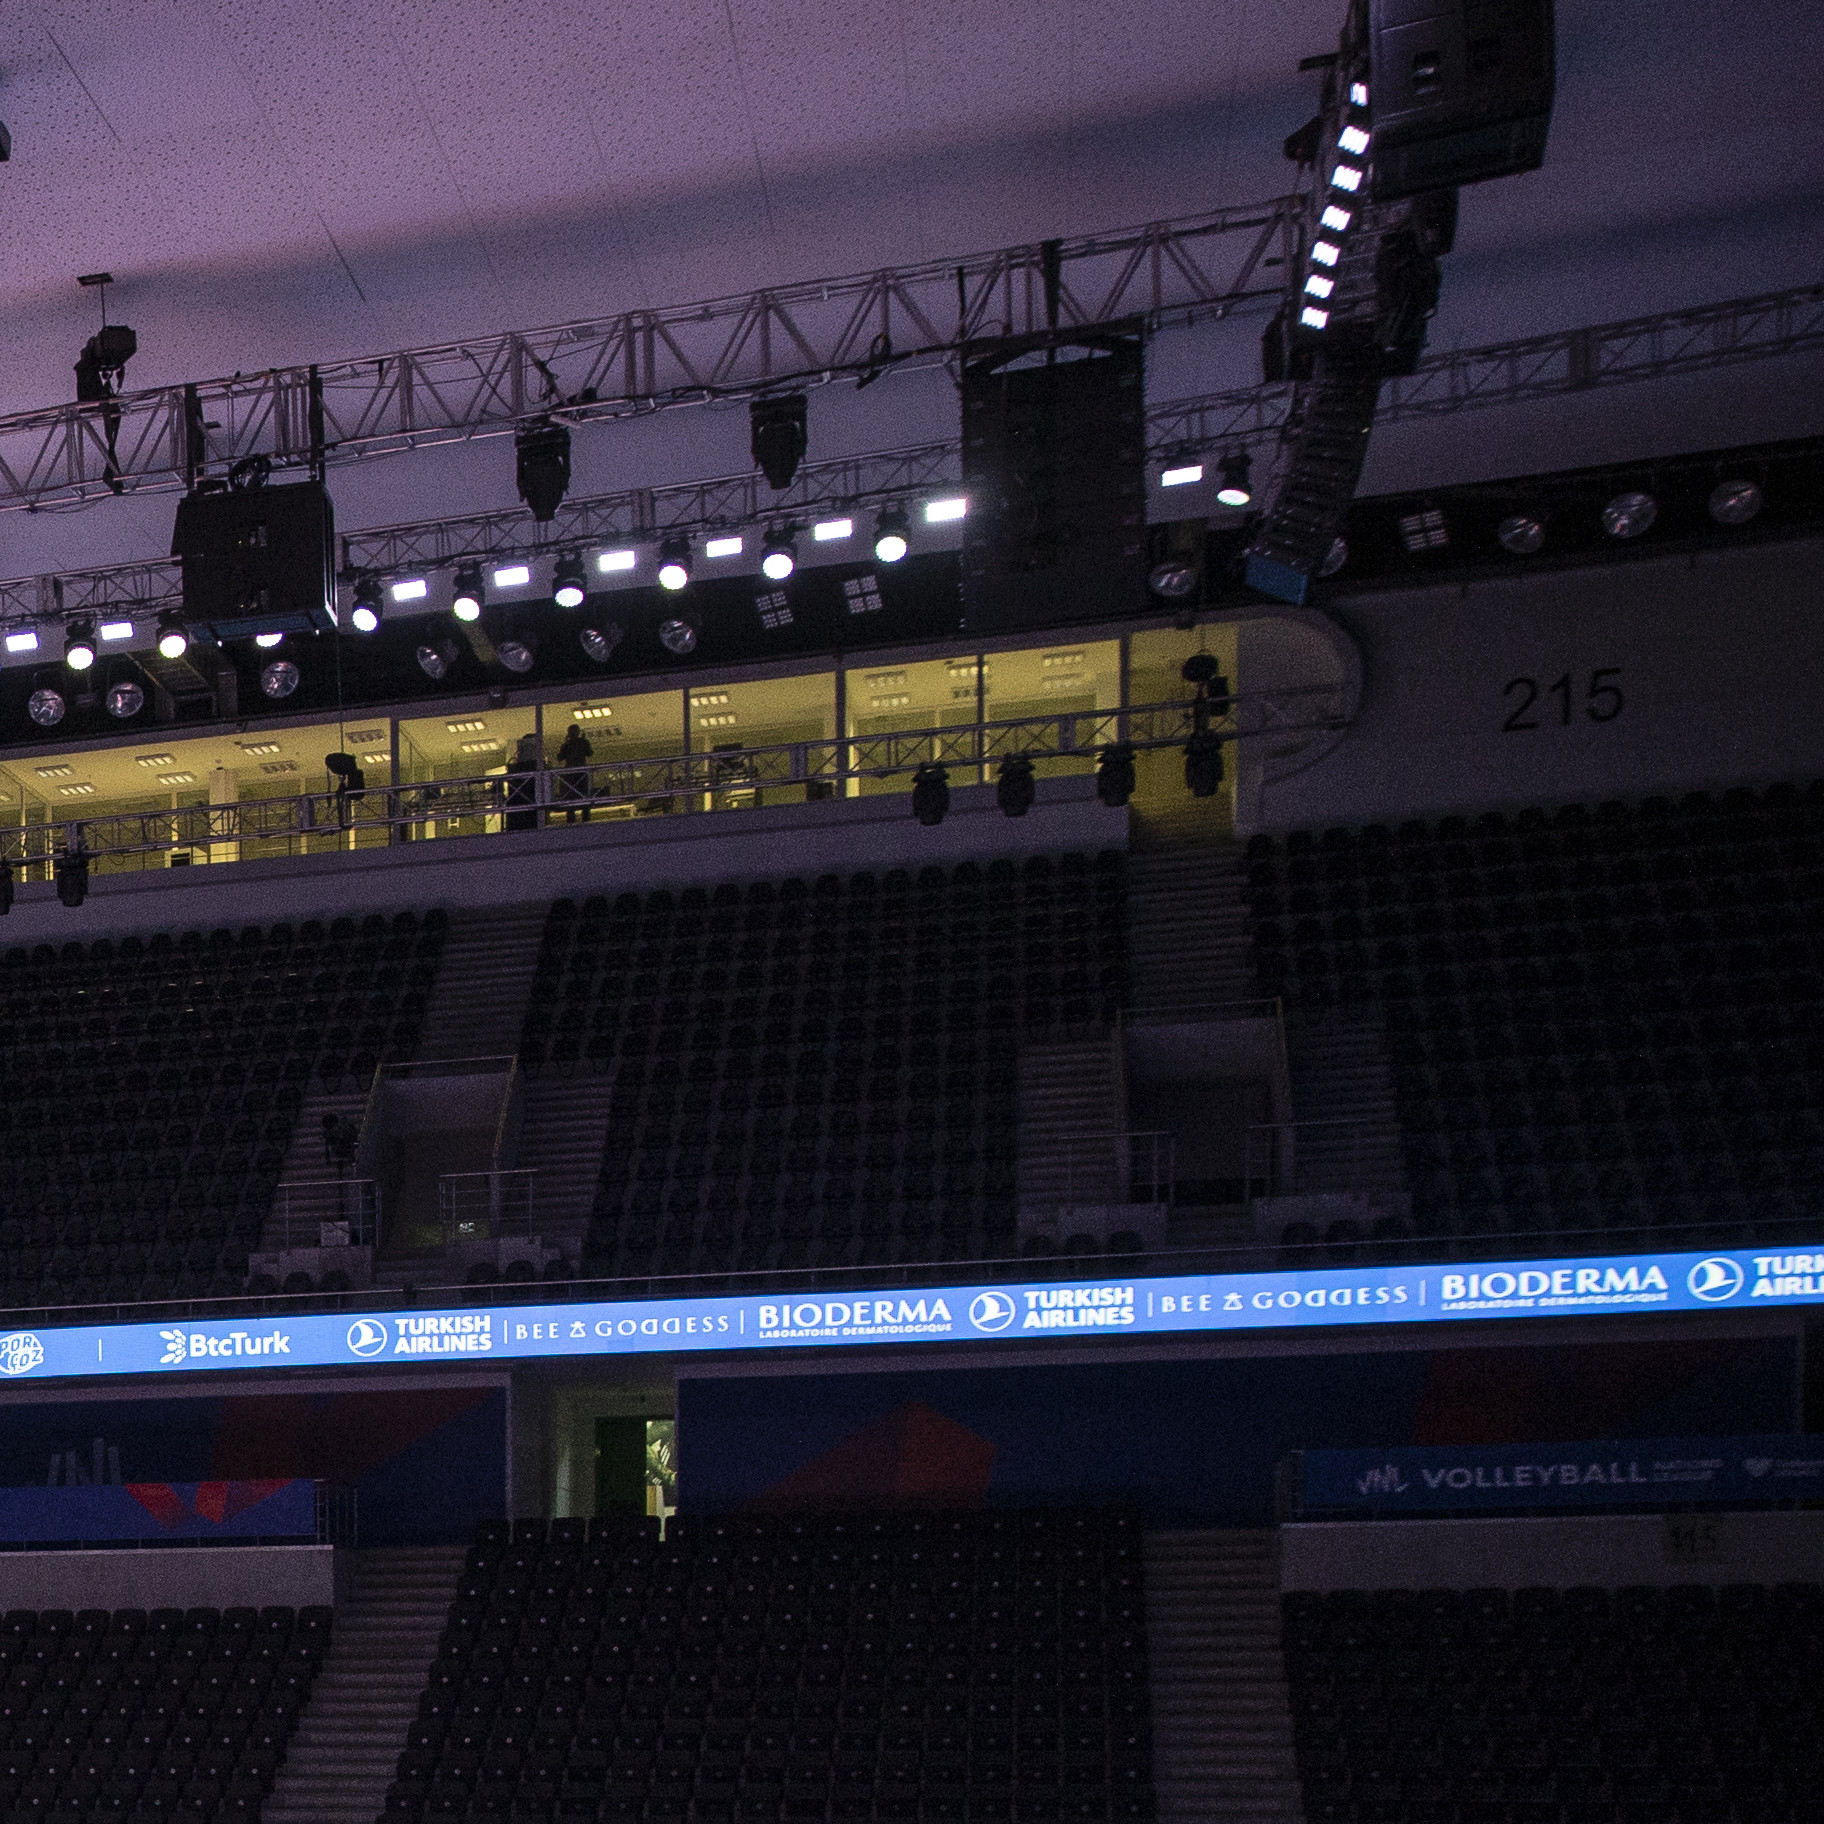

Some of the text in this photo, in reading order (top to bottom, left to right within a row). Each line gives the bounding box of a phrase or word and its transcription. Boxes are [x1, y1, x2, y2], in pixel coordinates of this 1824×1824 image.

[1501, 667, 1626, 732] 215
[1441, 1265, 1668, 1300] BIODERMA
[1750, 1275, 1824, 1298] AIRLI
[1022, 1286, 1134, 1310] TURKISH
[1161, 1294, 1212, 1314] BEE
[395, 1315, 491, 1334] TURKISH
[758, 1299, 953, 1330] BIODERMA
[1022, 1307, 1135, 1329] AIRLINES
[516, 1322, 560, 1341] BEE
[759, 1326, 842, 1340] LABORATOIRE
[189, 1330, 291, 1359] BtcTurk
[393, 1333, 492, 1354] AIRLINES
[1421, 1460, 1647, 1489] VOLLEYBALL
